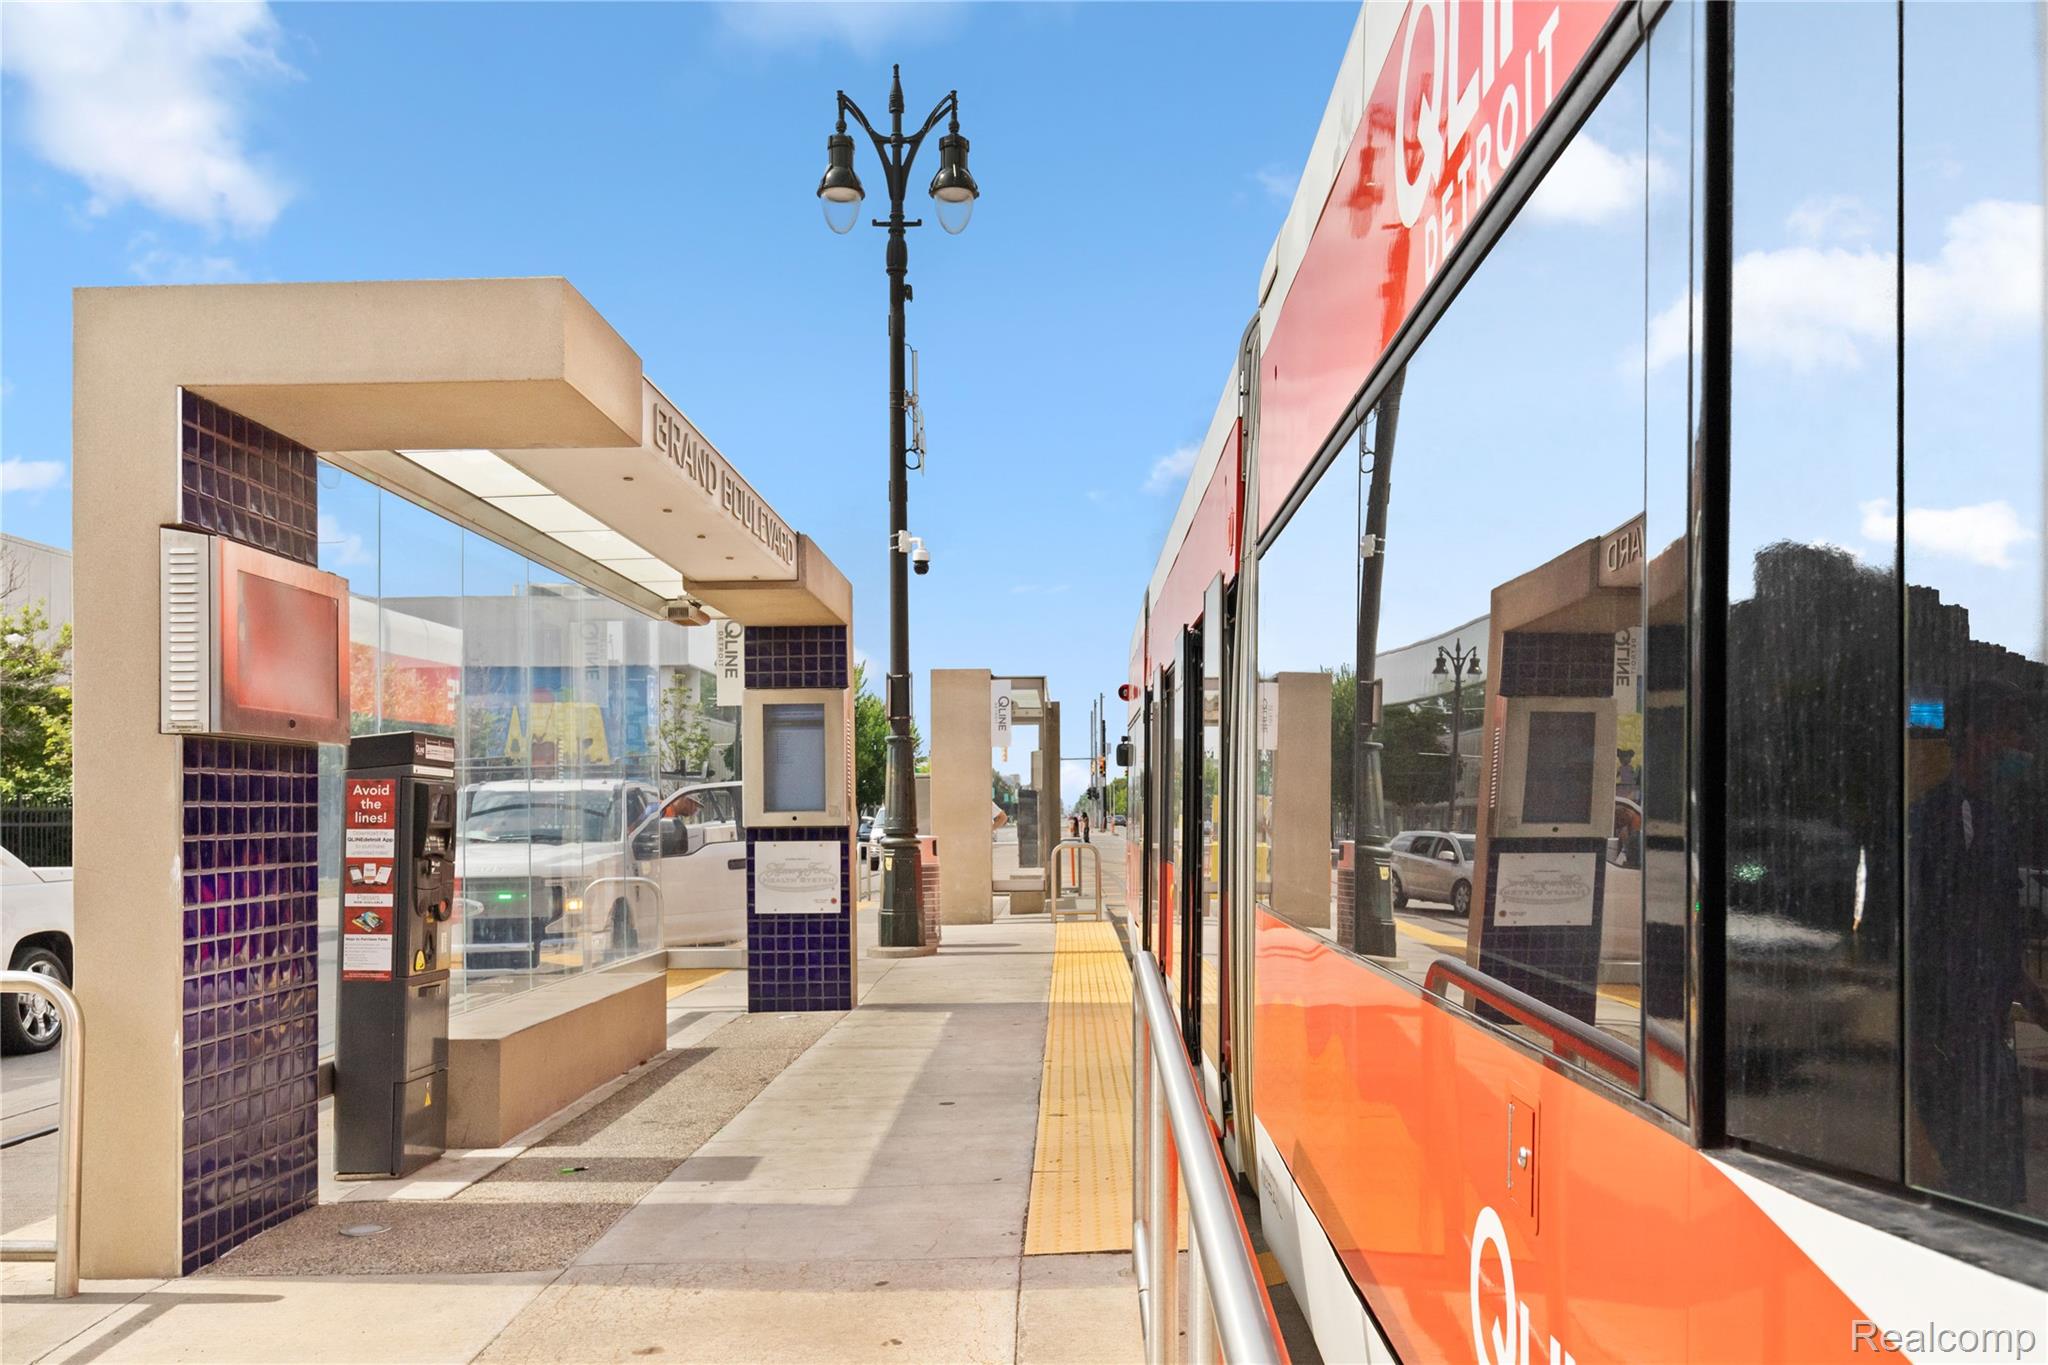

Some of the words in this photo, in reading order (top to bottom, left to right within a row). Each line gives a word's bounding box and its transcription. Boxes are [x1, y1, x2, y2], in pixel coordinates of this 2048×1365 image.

[1425, 5, 1559, 286] DETROIT
[653, 402, 717, 496] GRAND
[721, 470, 794, 566] BOULEVARD
[725, 620, 743, 678] QLINE
[998, 695, 1010, 731] QLINE
[353, 784, 390, 796] Avoid
[360, 798, 382, 810] the
[354, 811, 387, 824] lines!
